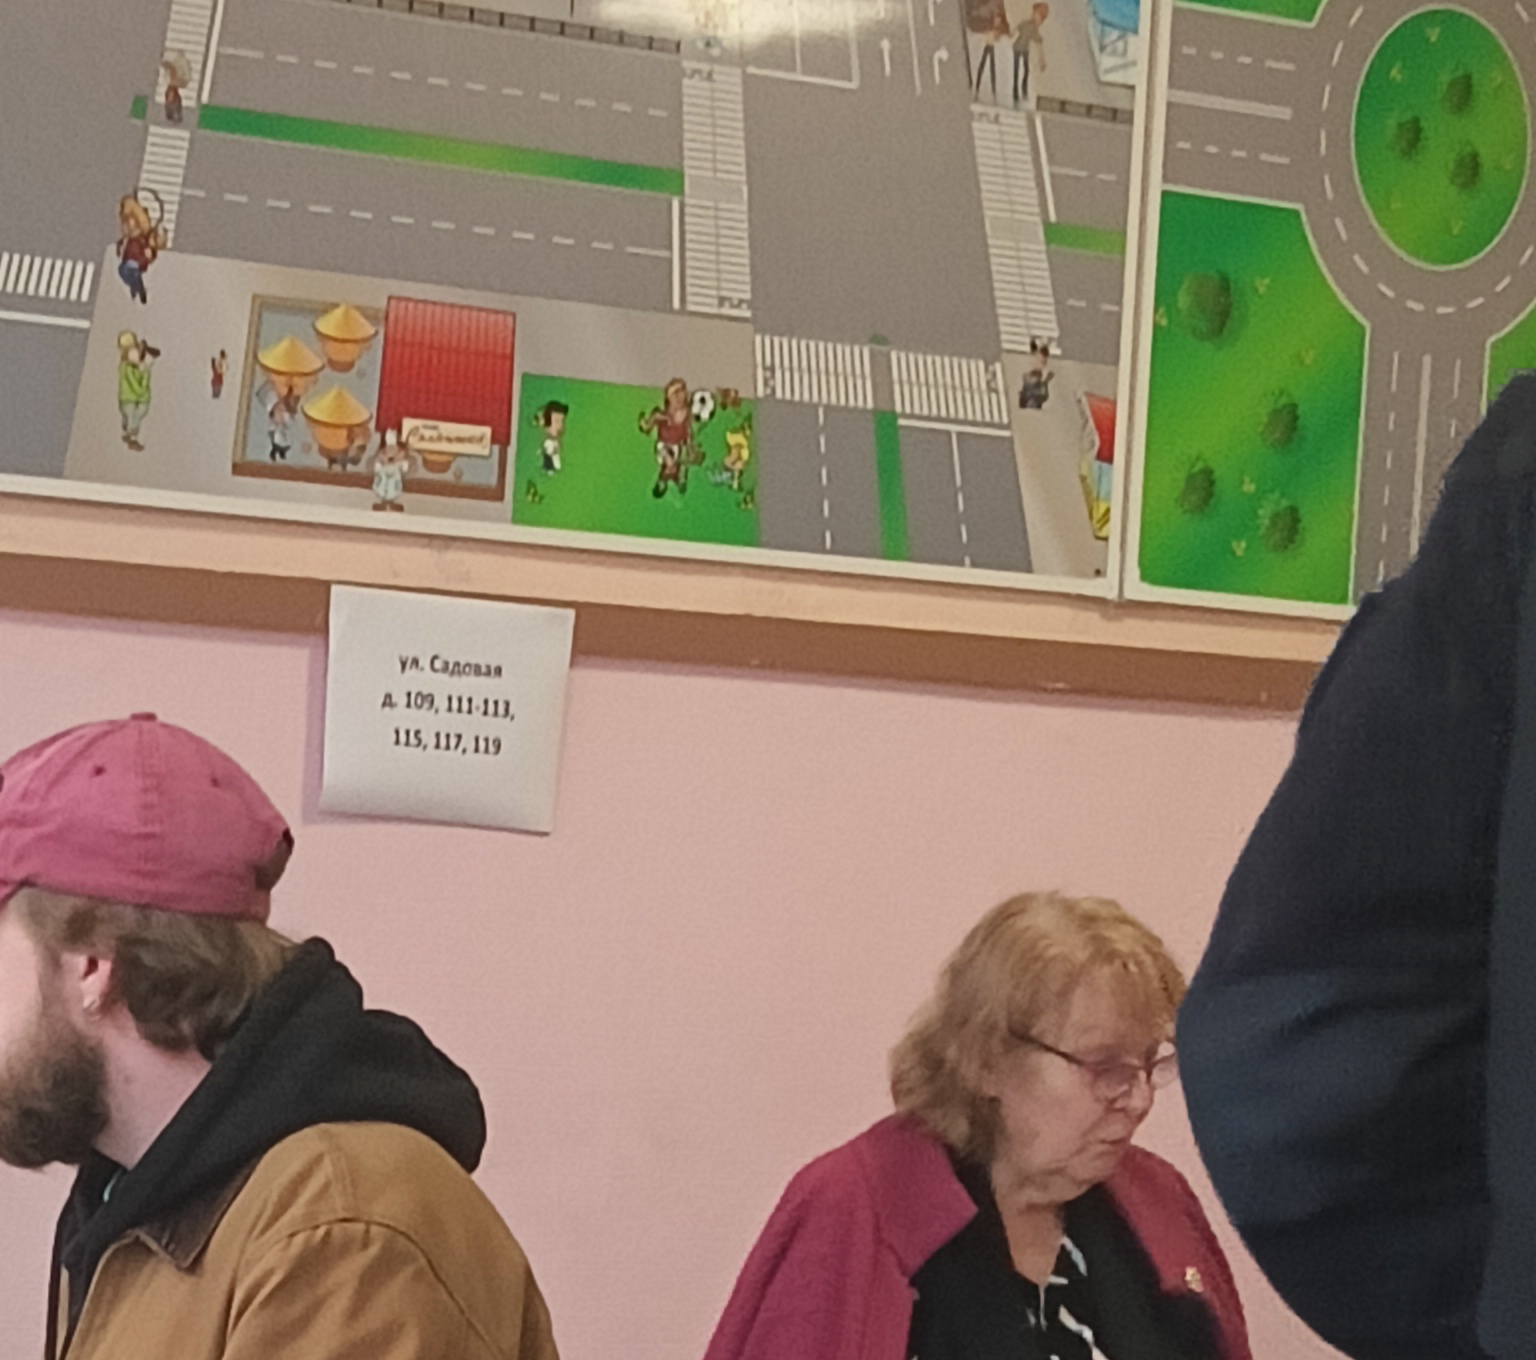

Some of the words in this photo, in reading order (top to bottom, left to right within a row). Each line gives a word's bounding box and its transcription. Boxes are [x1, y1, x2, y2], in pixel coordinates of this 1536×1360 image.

[398, 655, 424, 674] ул.
[429, 654, 503, 678] Садовая
[381, 692, 398, 710] д.
[405, 691, 439, 714] 109,
[445, 694, 515, 721] 111-113,
[393, 727, 428, 751] 115,
[433, 731, 467, 755] 117,
[473, 735, 502, 755] 119
